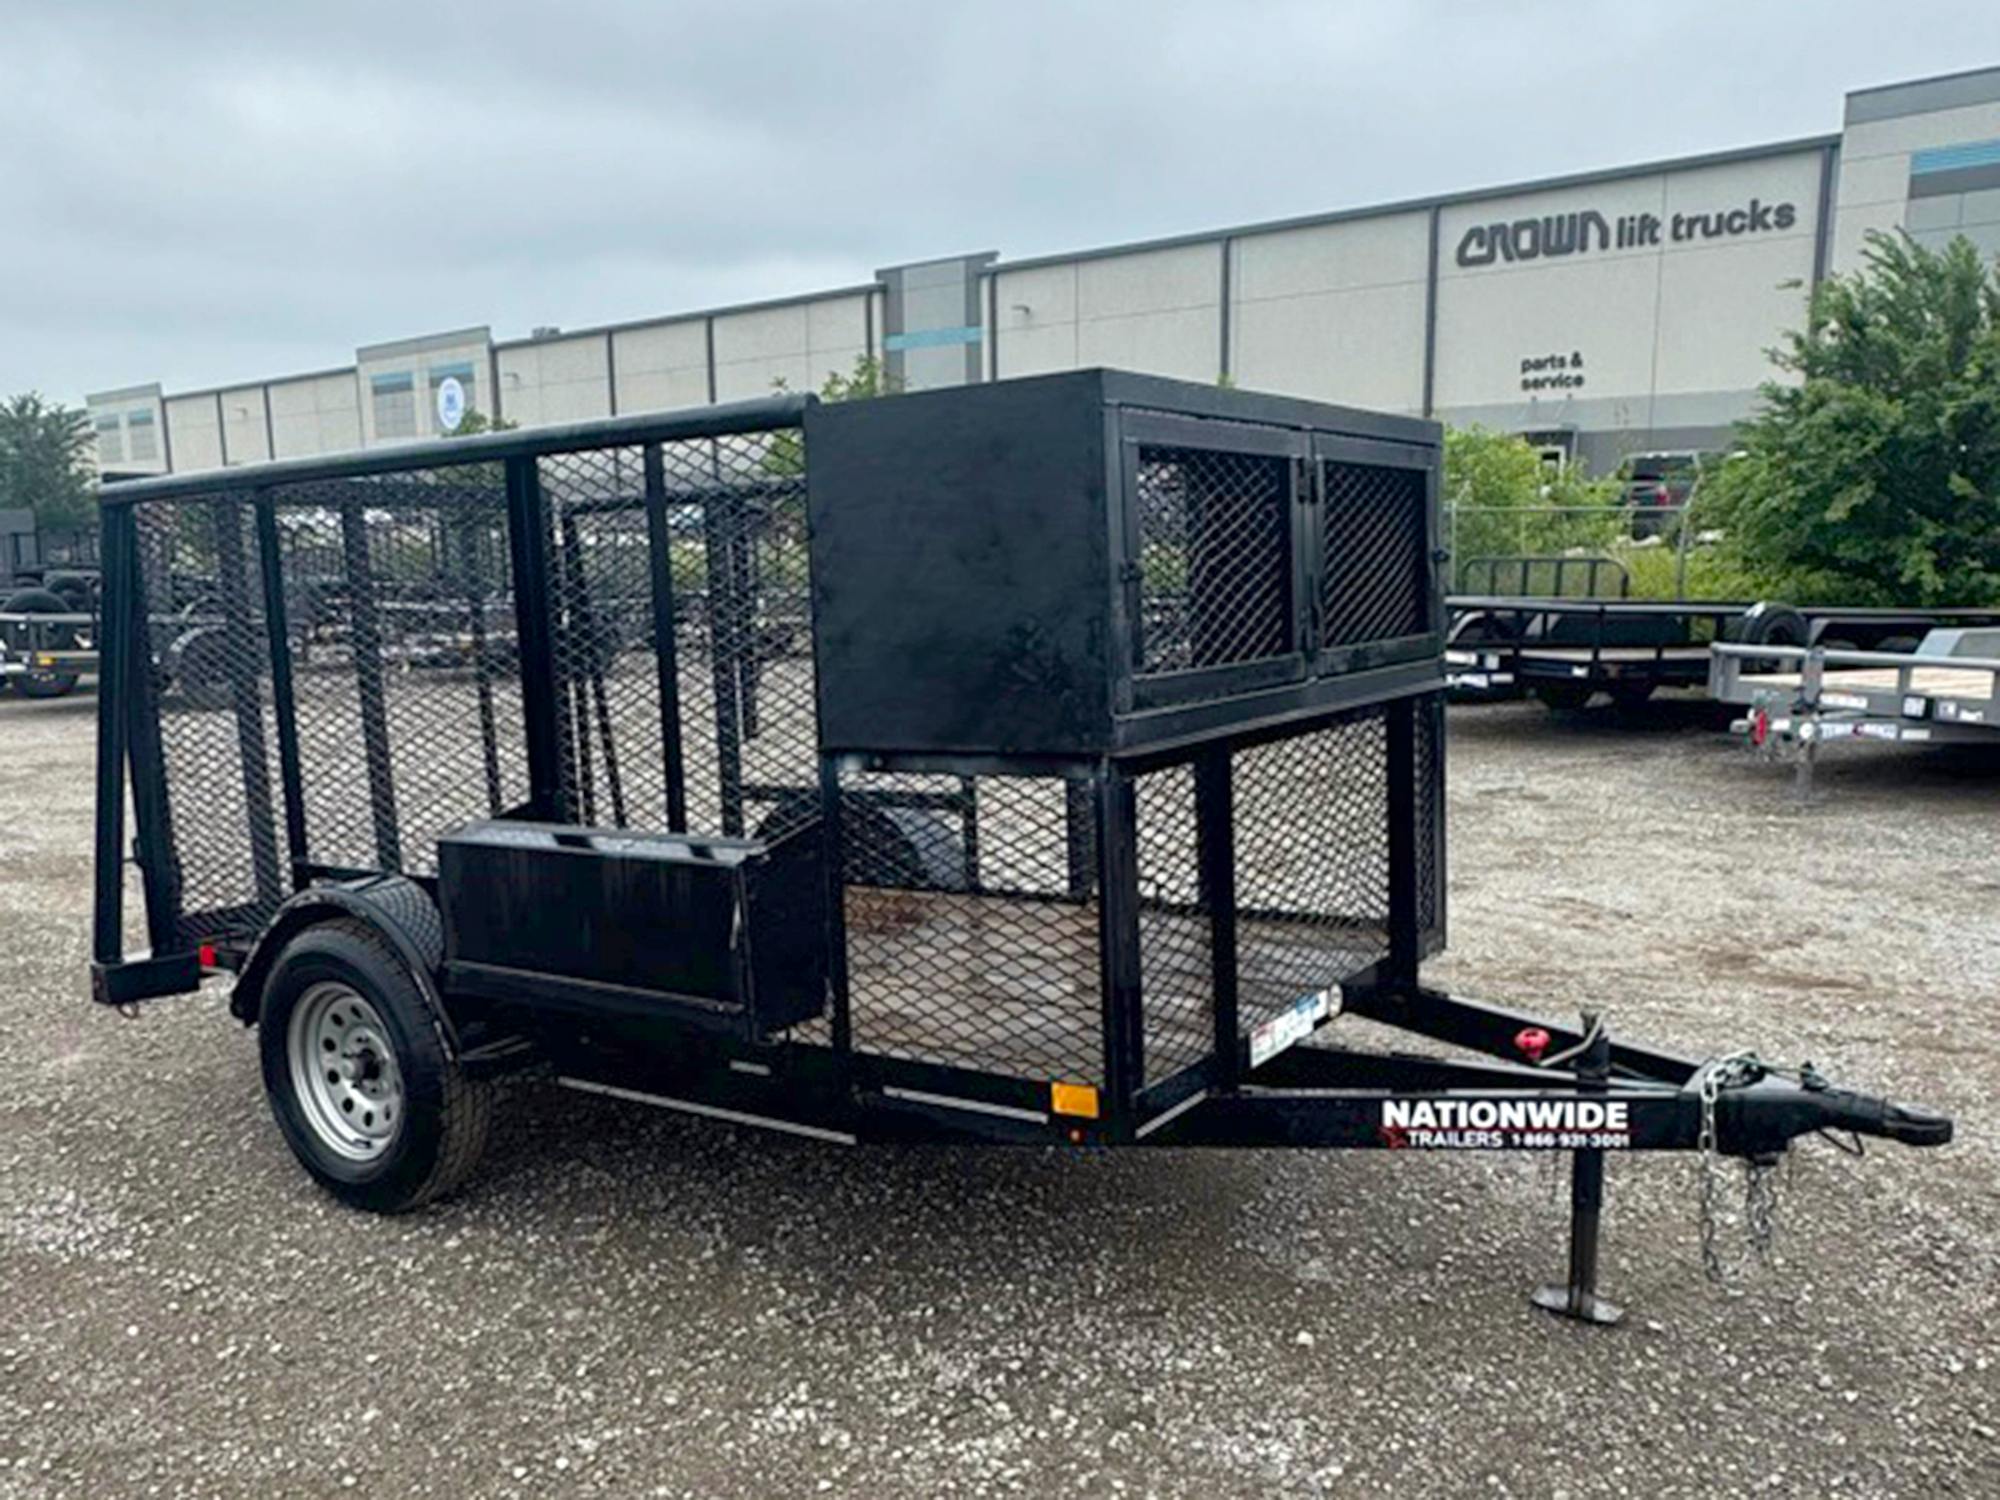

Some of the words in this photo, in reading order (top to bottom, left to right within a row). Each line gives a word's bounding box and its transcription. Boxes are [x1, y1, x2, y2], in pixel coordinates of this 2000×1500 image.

[1456, 209, 1610, 268] CROWN
[1616, 212, 1662, 249] lift
[1671, 198, 1796, 242] trucks
[1521, 354, 1566, 375] parts
[1570, 350, 1583, 369] &
[1521, 373, 1584, 392] service
[1381, 1101, 1629, 1130] NATIONWIDE
[1407, 1129, 1504, 1148] TRAILERS
